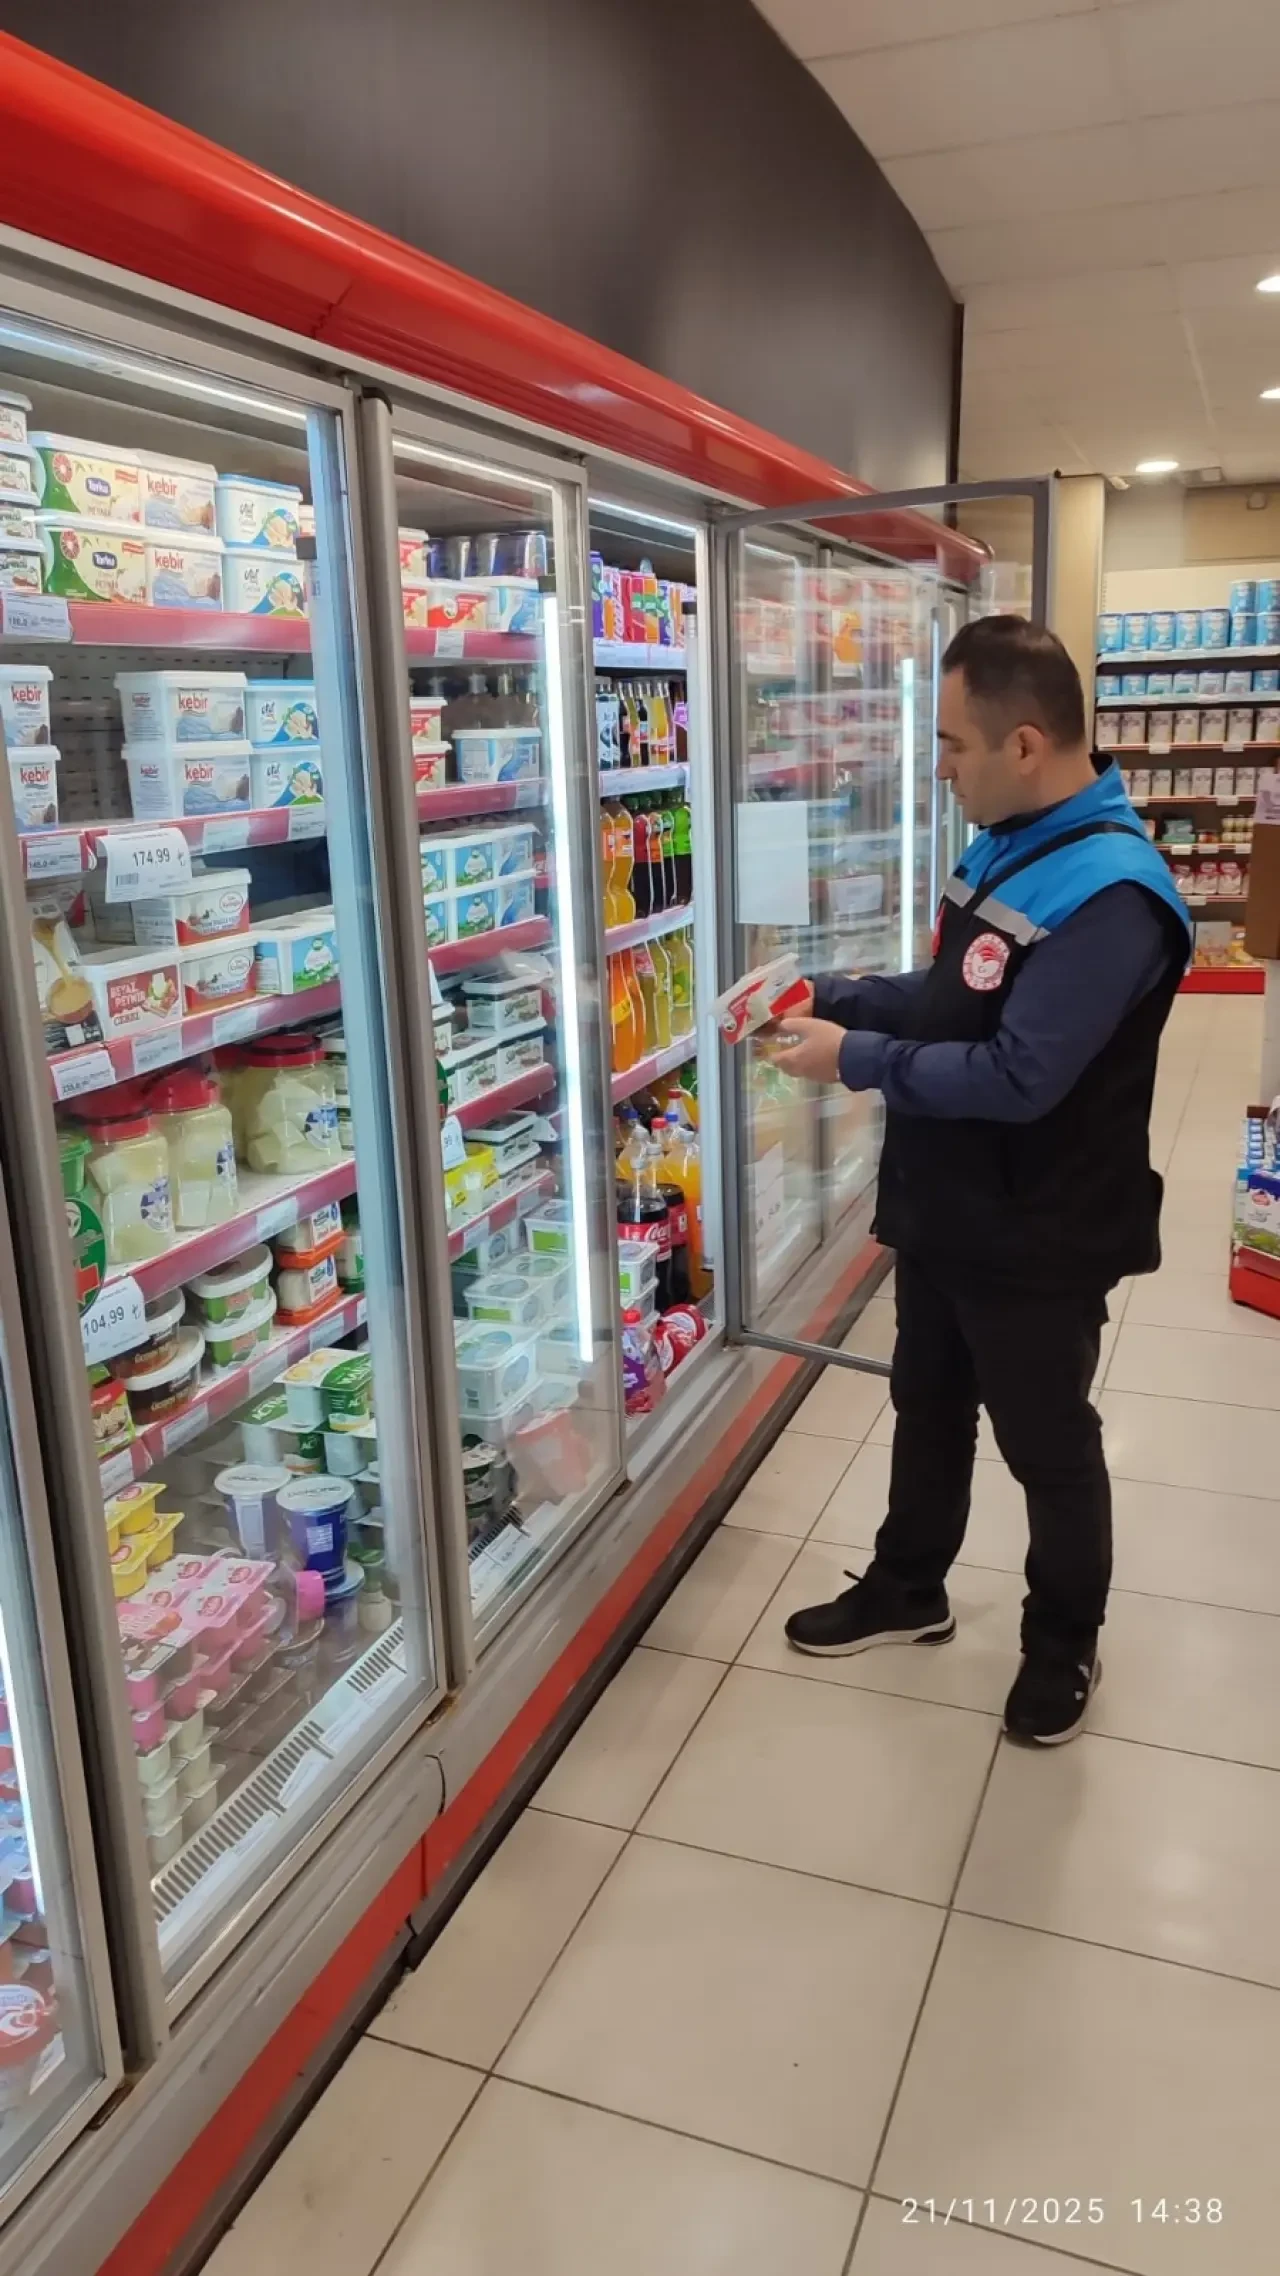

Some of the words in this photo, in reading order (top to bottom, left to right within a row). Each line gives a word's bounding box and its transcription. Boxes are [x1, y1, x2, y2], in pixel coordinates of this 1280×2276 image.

[146, 474, 177, 495] kebir
[154, 549, 184, 569] kebir
[11, 685, 42, 702] kebir
[178, 693, 208, 709] kebir
[20, 766, 50, 784] kebir
[184, 763, 214, 780] kebir
